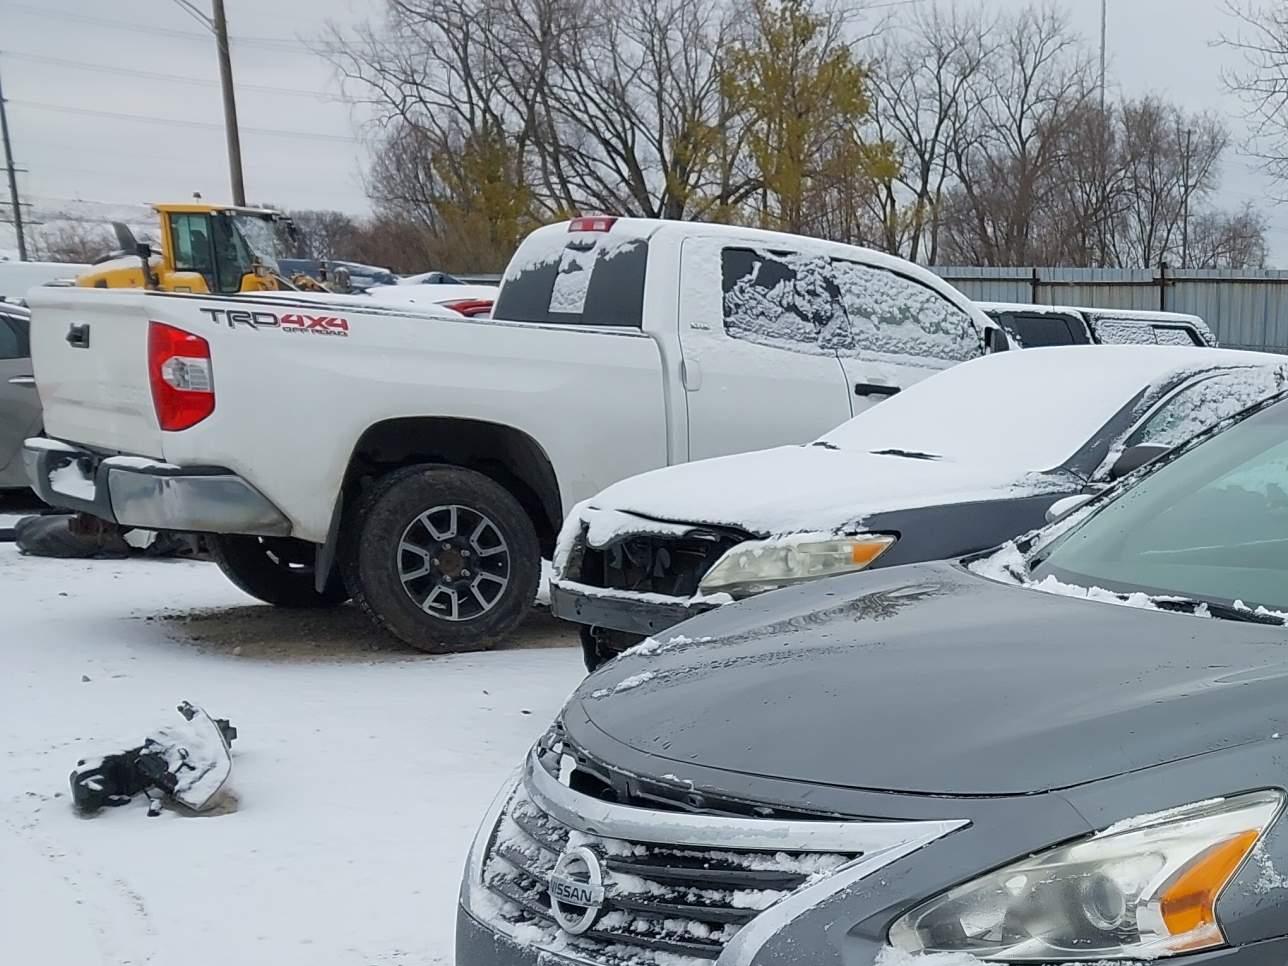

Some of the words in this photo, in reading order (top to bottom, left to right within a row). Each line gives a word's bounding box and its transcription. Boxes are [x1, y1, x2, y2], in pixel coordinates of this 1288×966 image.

[200, 308, 279, 329] TRD
[311, 328, 349, 337] ROAD
[551, 882, 592, 902] NISSAN
